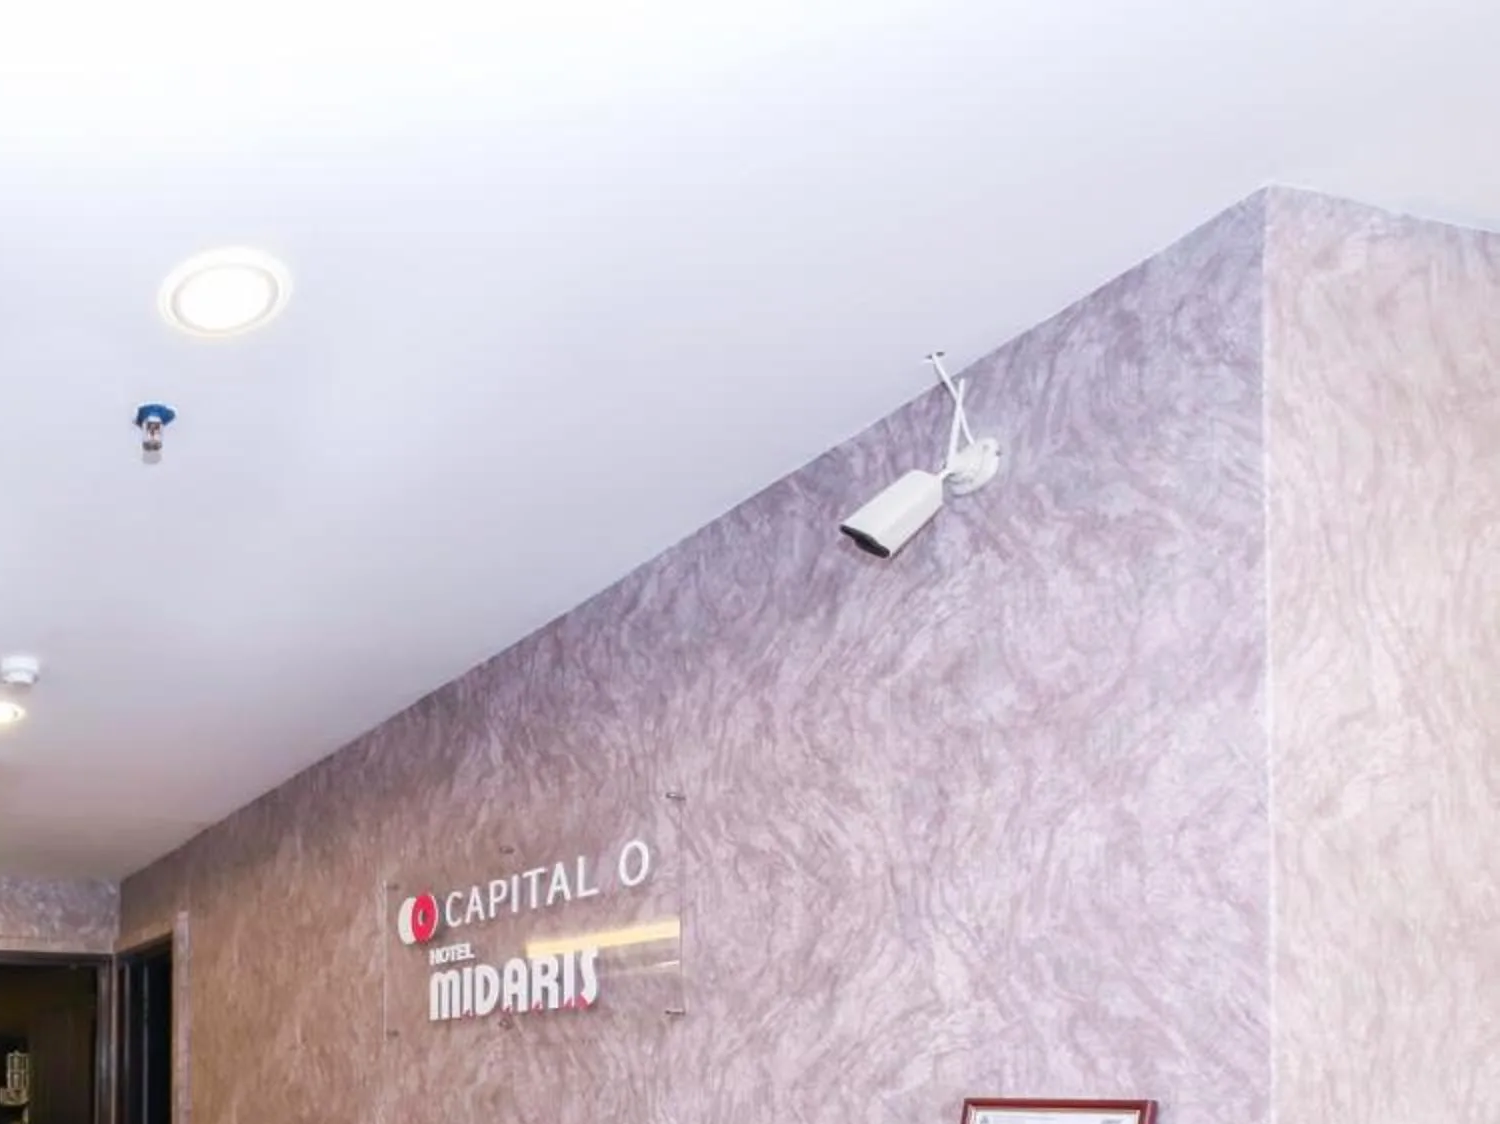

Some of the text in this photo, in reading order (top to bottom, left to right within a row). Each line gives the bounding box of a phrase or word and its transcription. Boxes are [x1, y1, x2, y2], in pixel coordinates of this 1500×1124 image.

[445, 840, 650, 928] CAPITAL O
[429, 943, 476, 966] HOTEL
[429, 945, 599, 1021] MIDARIS
